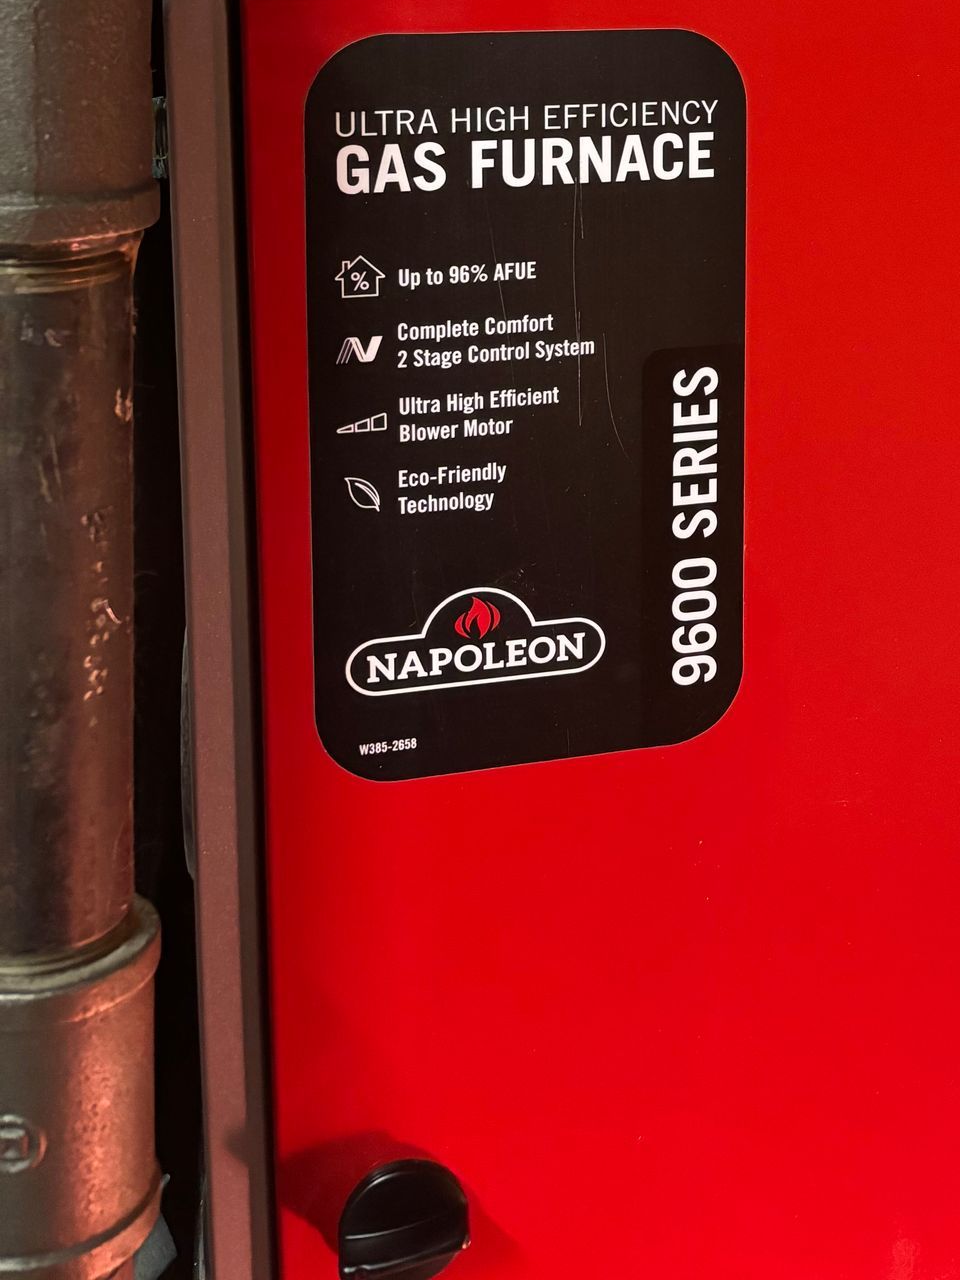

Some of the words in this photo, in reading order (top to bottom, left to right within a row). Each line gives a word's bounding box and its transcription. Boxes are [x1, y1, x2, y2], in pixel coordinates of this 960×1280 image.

[335, 108, 438, 138] ULTRA
[451, 105, 529, 133] HIGH
[543, 99, 719, 131] EFFICIENCY
[336, 141, 446, 195] GAS
[471, 131, 716, 189] FURNACE
[398, 268, 420, 290] Up
[426, 269, 443, 286] to
[449, 264, 488, 284] 96%
[493, 261, 536, 282] AFUE
[397, 319, 479, 342] Complete
[484, 313, 553, 336] Comfort
[397, 350, 407, 368] 2
[413, 347, 462, 369] Stage
[468, 342, 530, 363] Control
[535, 338, 595, 361] System
[399, 395, 441, 415] Ultra
[446, 392, 484, 415] High
[490, 386, 559, 408] Efficient
[399, 422, 458, 442] Blower
[463, 418, 513, 438] Motor
[671, 366, 719, 539] SERIES
[398, 461, 507, 488] Eco-Friendly
[398, 491, 494, 514] Technology
[671, 556, 718, 686] 9600
[366, 632, 586, 684] NAPOLEON
[359, 738, 417, 756] W385-2658
